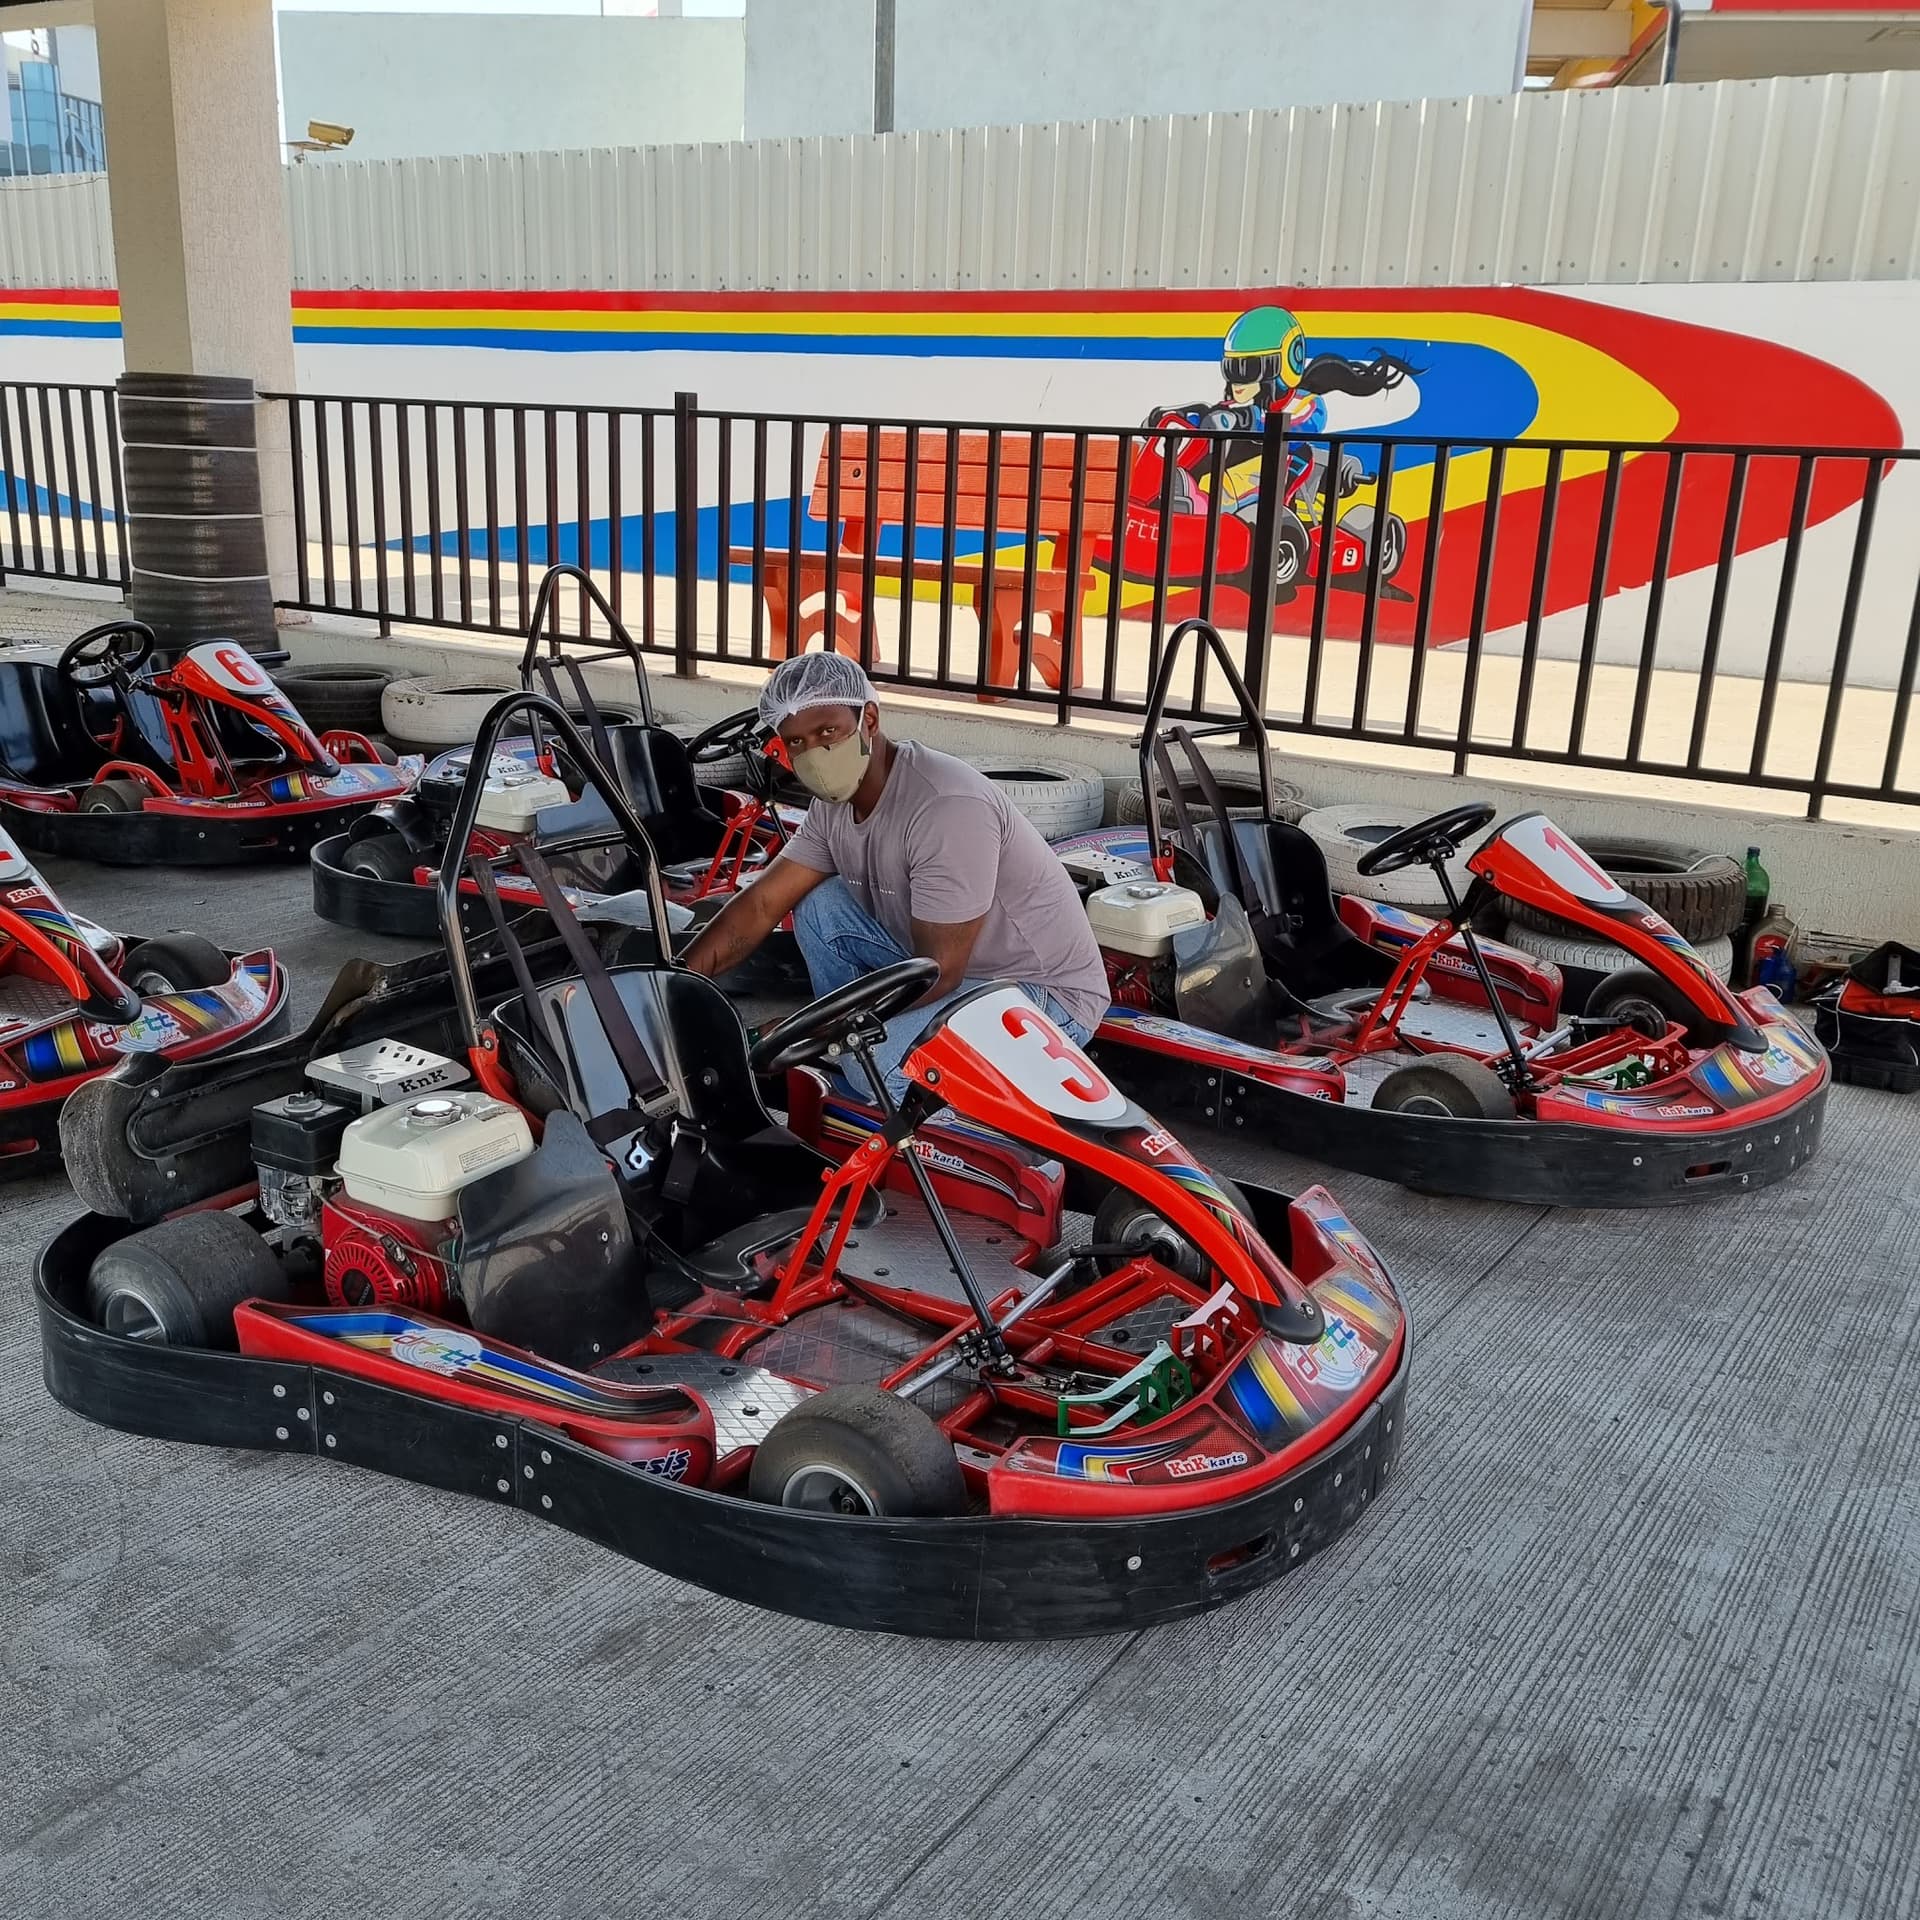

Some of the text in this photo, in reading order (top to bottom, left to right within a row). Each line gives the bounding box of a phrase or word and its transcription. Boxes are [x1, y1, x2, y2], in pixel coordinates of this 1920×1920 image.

[1345, 548, 1355, 562] 9
[214, 649, 264, 686] 6
[1542, 826, 1615, 892] 1
[1113, 867, 1143, 880] KnK
[1001, 1005, 1111, 1103] 3
[398, 1069, 449, 1093] KnK
[1659, 1107, 1686, 1117] KnK
[914, 1142, 962, 1167] nK karts
[1168, 1454, 1245, 1476] KnK karts
